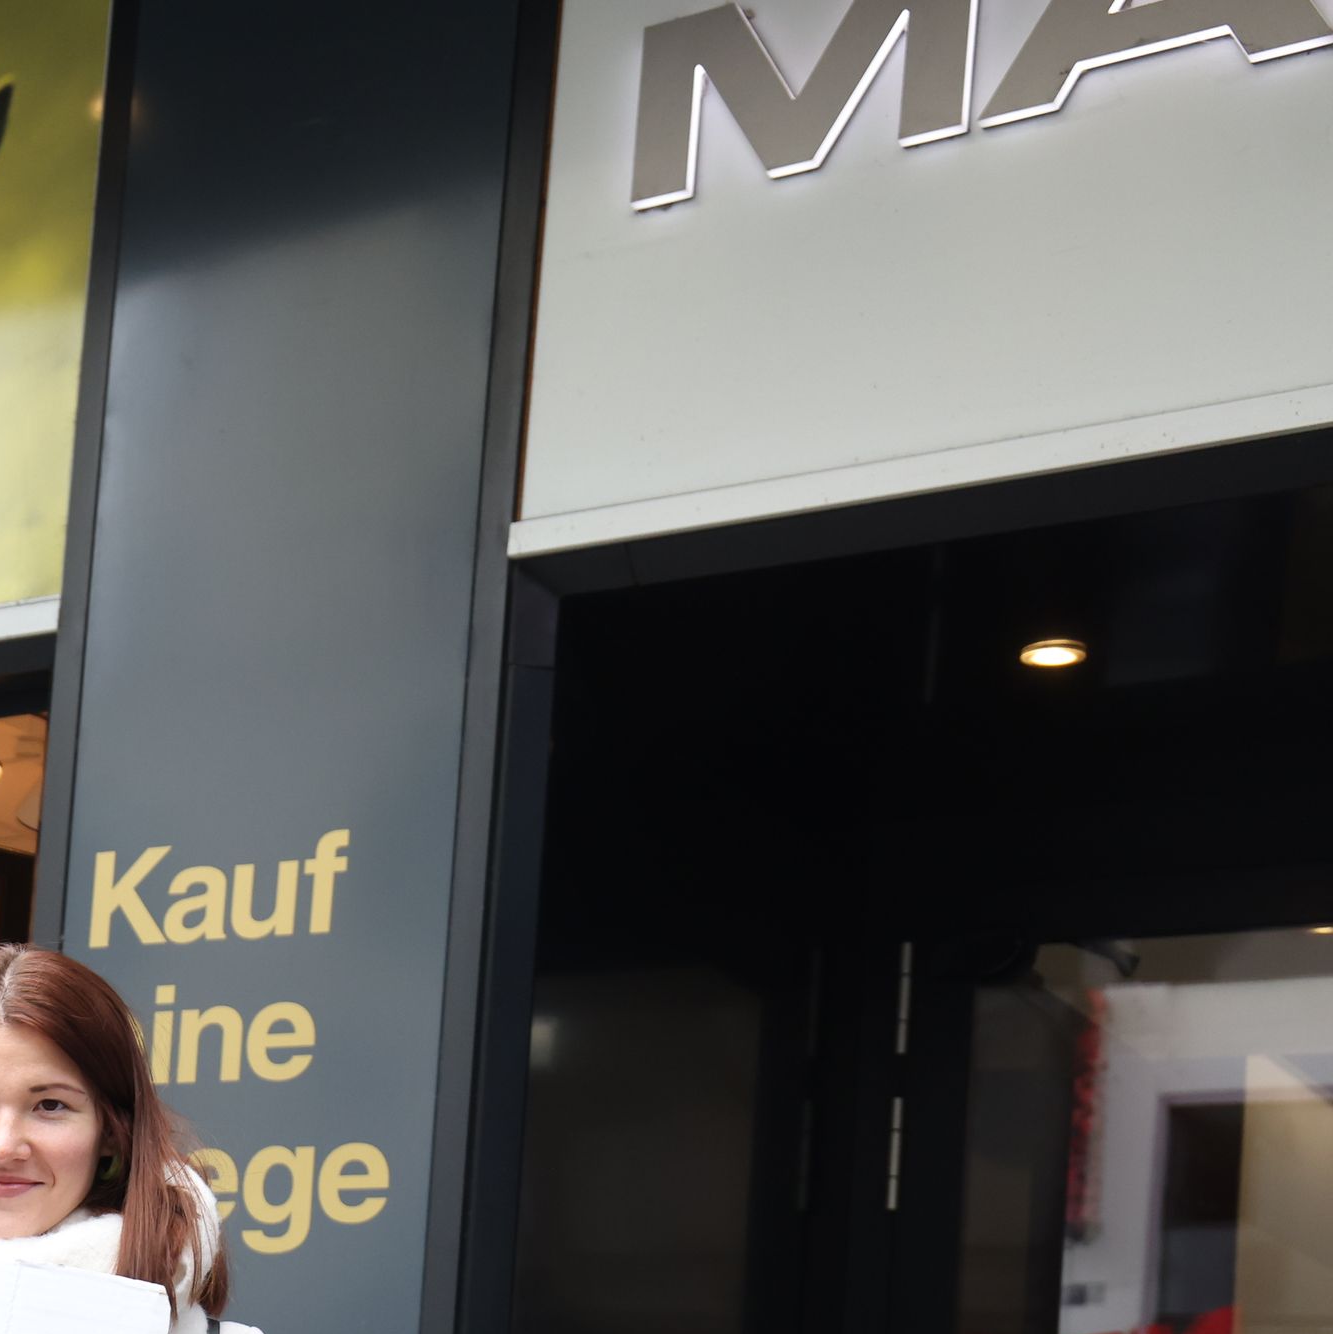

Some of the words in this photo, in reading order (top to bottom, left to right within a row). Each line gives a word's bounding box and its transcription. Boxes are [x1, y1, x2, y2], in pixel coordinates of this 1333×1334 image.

[88, 828, 351, 949] Kauf
[127, 984, 316, 1084] ine
[188, 1141, 390, 1254] ege
